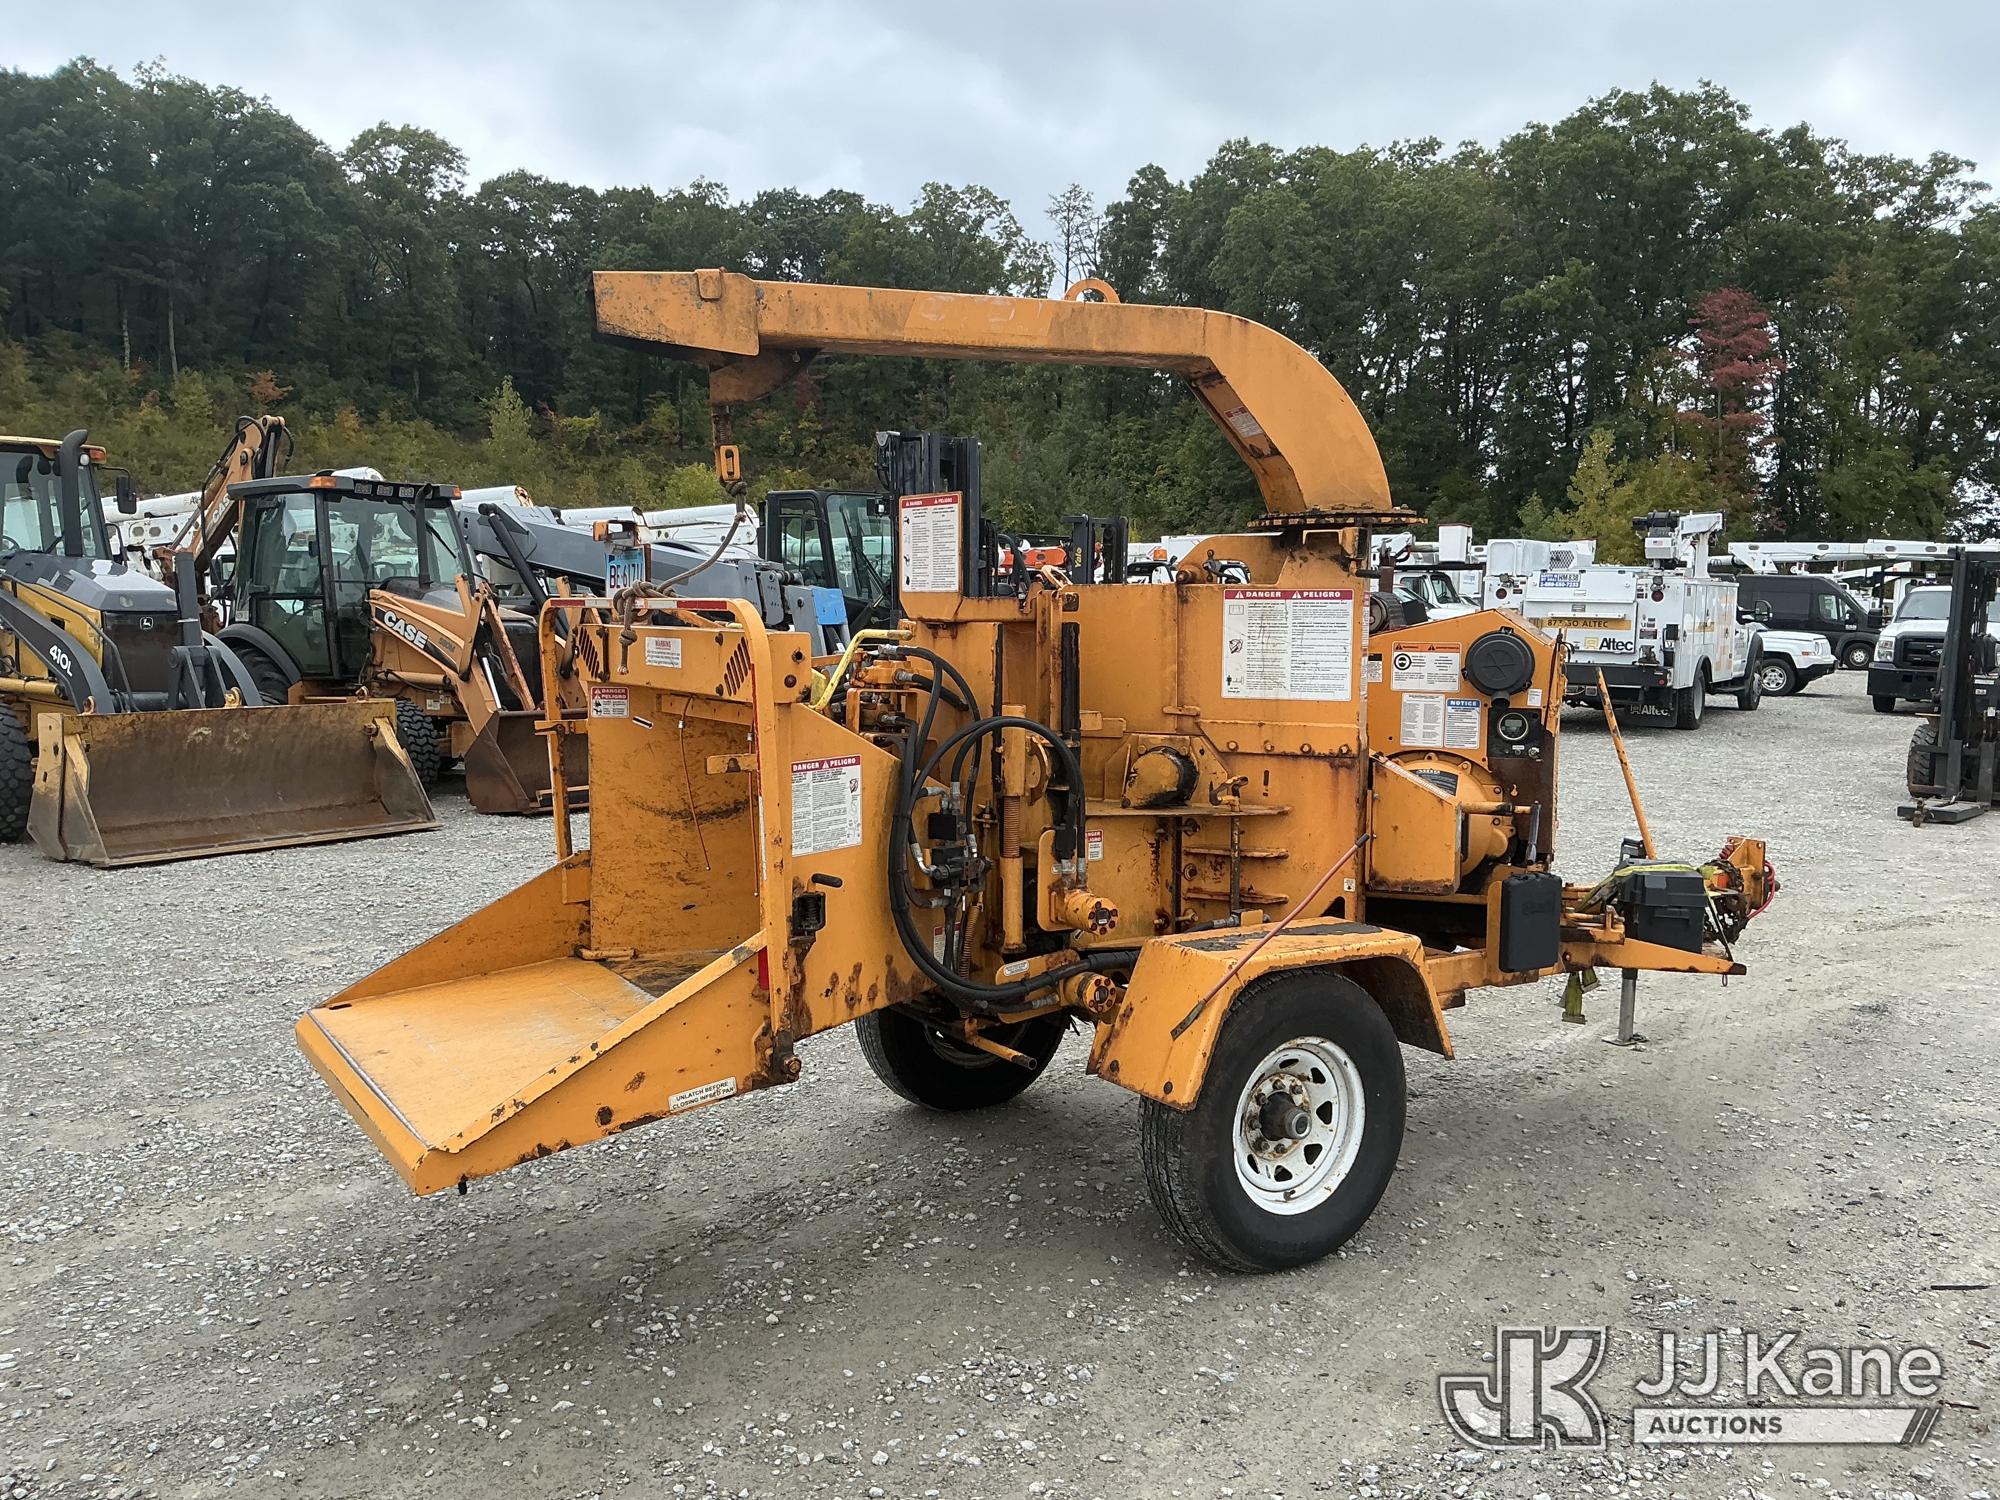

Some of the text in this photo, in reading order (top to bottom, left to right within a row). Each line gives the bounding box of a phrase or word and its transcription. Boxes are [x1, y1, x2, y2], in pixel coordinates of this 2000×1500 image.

[384, 611, 429, 649] CASE
[1581, 620, 1609, 628] ALTEC
[1599, 638, 1634, 651] Altec
[49, 645, 73, 677] 410L
[1641, 705, 1669, 716] Altec
[792, 757, 856, 772] DANGER PELIGRO
[672, 1097, 699, 1110] CLOSING
[722, 1087, 734, 1095] PAN
[676, 1081, 728, 1101] UNLATCH BEFORE
